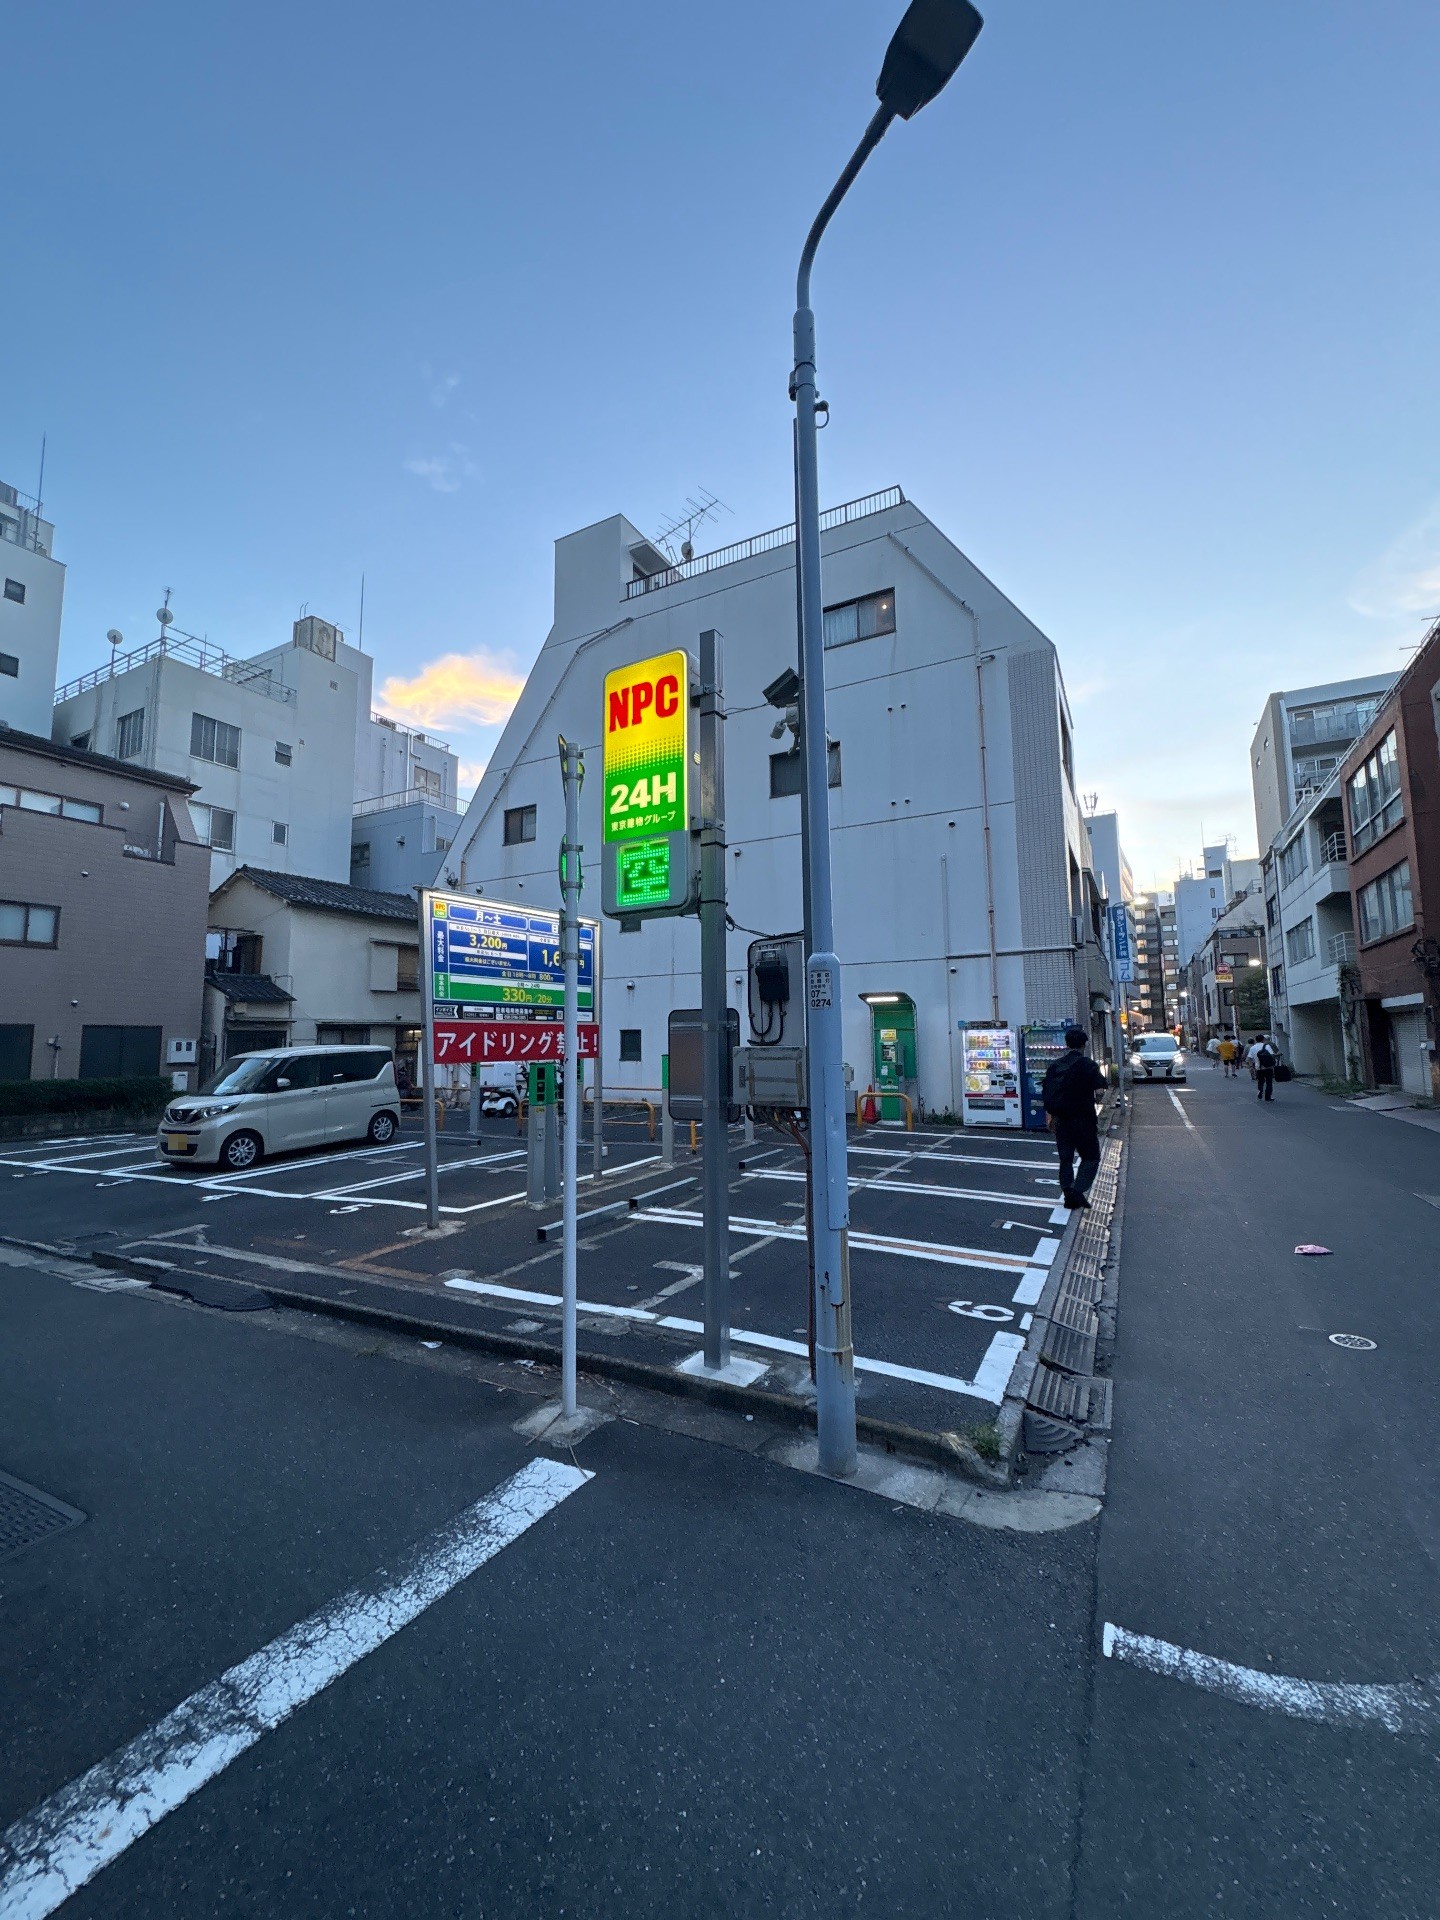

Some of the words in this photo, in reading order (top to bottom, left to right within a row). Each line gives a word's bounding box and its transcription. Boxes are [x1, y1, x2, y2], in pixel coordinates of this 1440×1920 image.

[609, 674, 679, 733] NPC
[610, 771, 677, 815] 24H
[611, 810, 677, 832] 東京建物グループ
[622, 841, 670, 906] 空
[470, 934, 508, 950] 3,200円
[811, 999, 831, 1007] 0274
